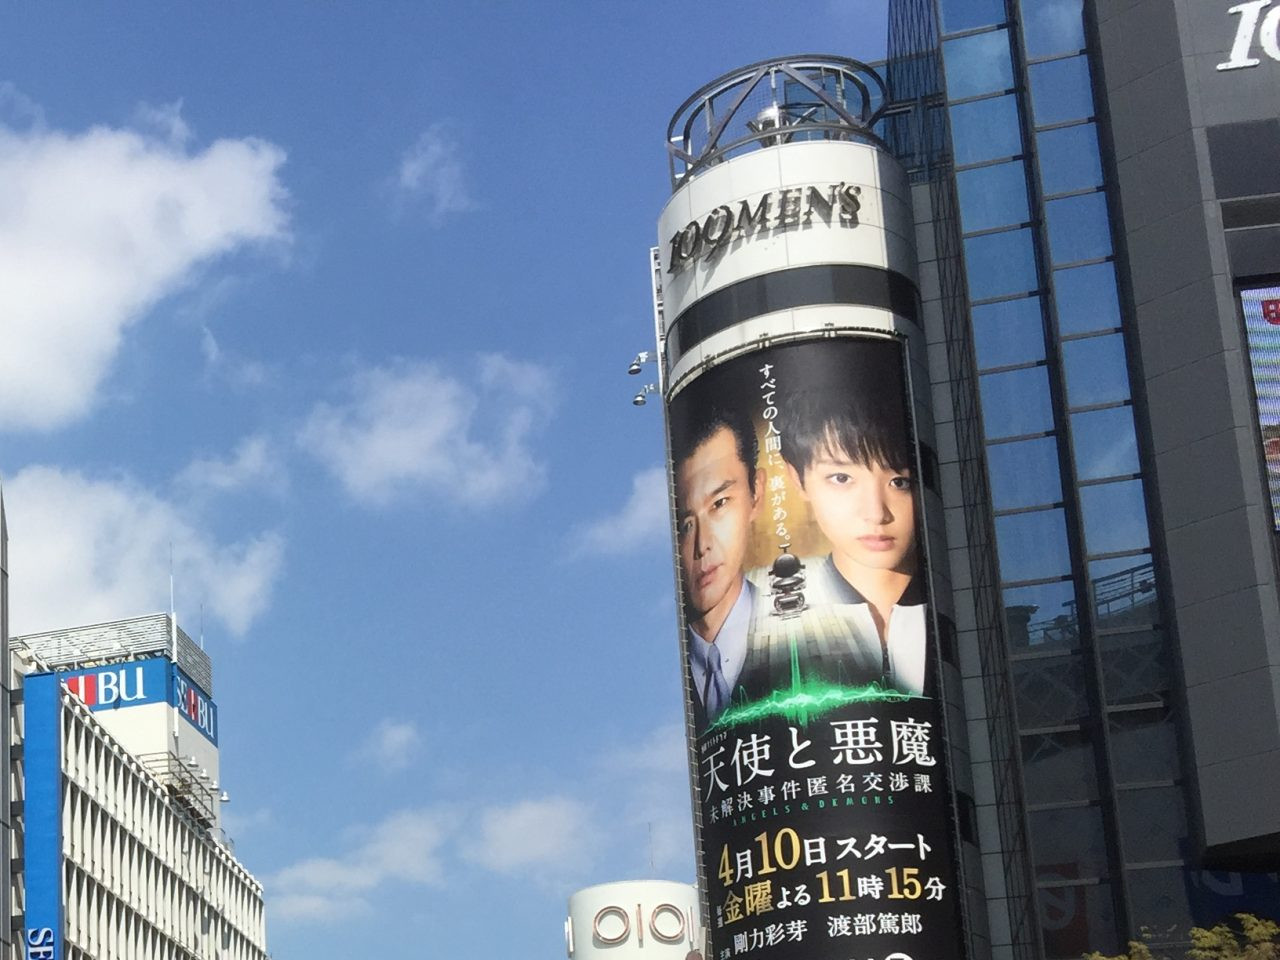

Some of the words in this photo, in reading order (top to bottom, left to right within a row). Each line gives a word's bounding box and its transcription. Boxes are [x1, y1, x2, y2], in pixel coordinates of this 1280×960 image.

[702, 717, 937, 803] 天使と悪魔
[709, 772, 933, 824] 未解決事件匿名交渉課
[733, 919, 808, 956] 剛力彩芽
[827, 912, 923, 938] 渡部篤郎
